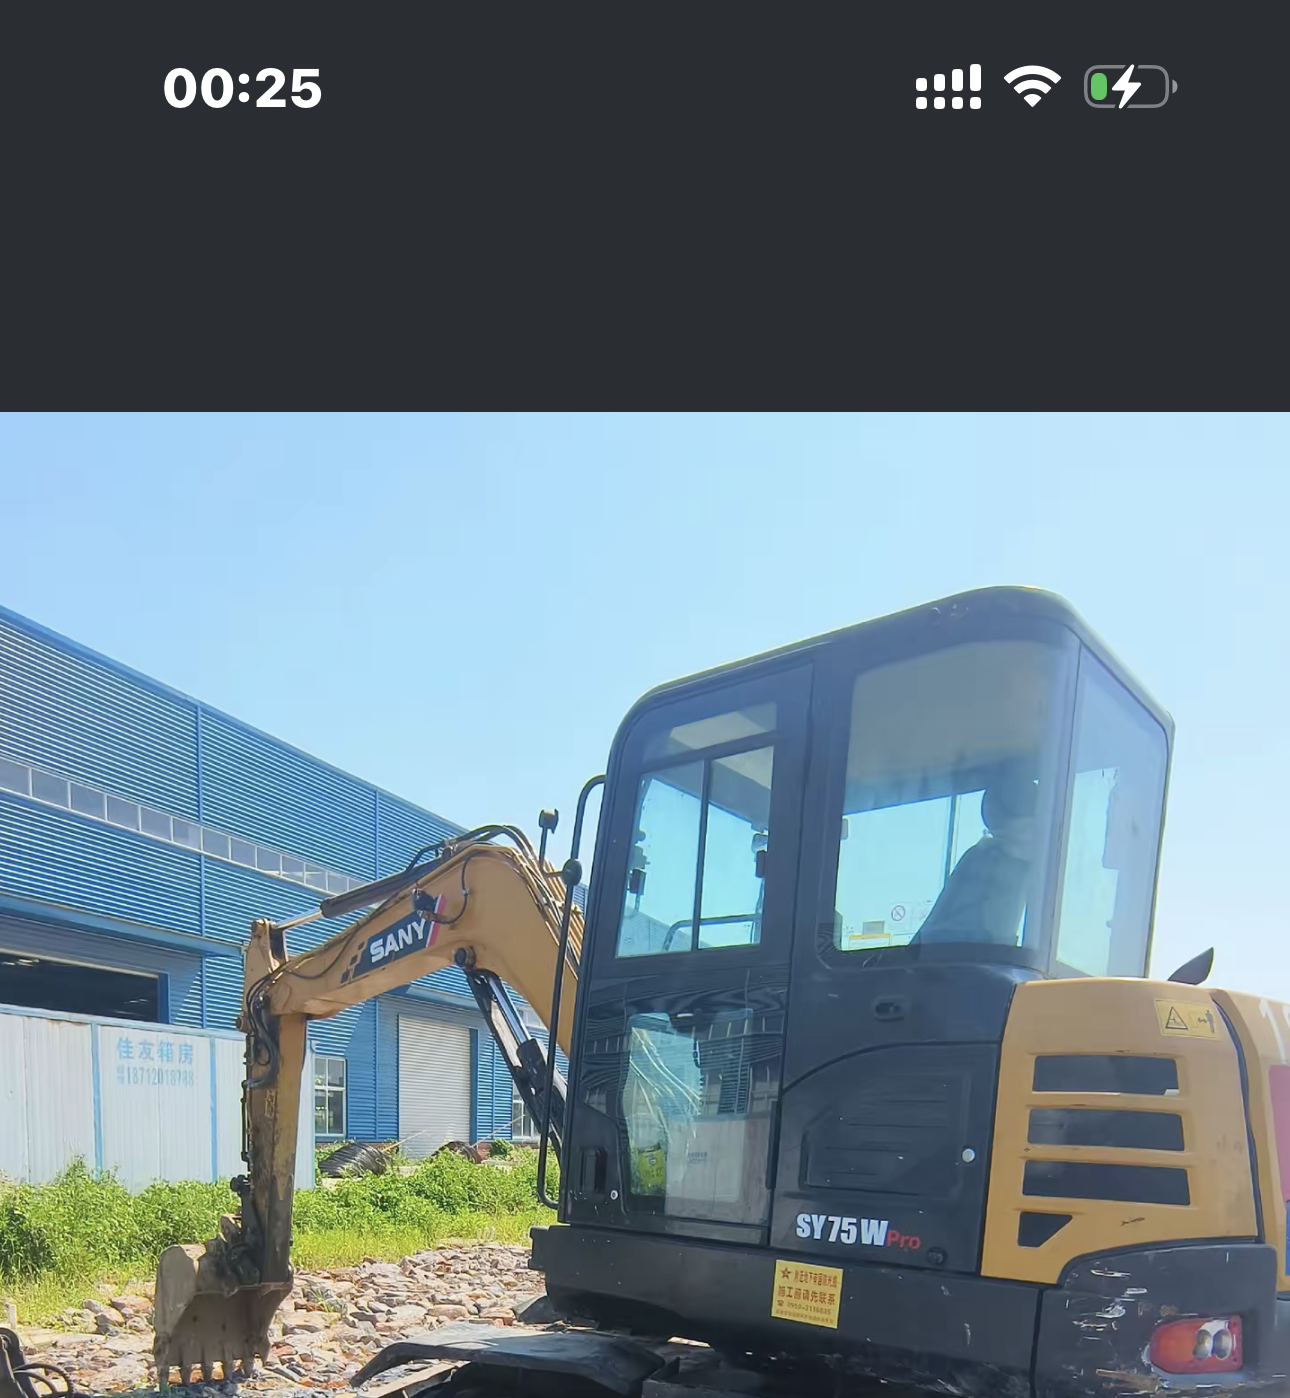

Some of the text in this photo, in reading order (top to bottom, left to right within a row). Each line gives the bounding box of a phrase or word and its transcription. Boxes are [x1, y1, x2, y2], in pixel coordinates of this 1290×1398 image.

[370, 917, 426, 963] SANY
[117, 1037, 194, 1065] 佳友箱房
